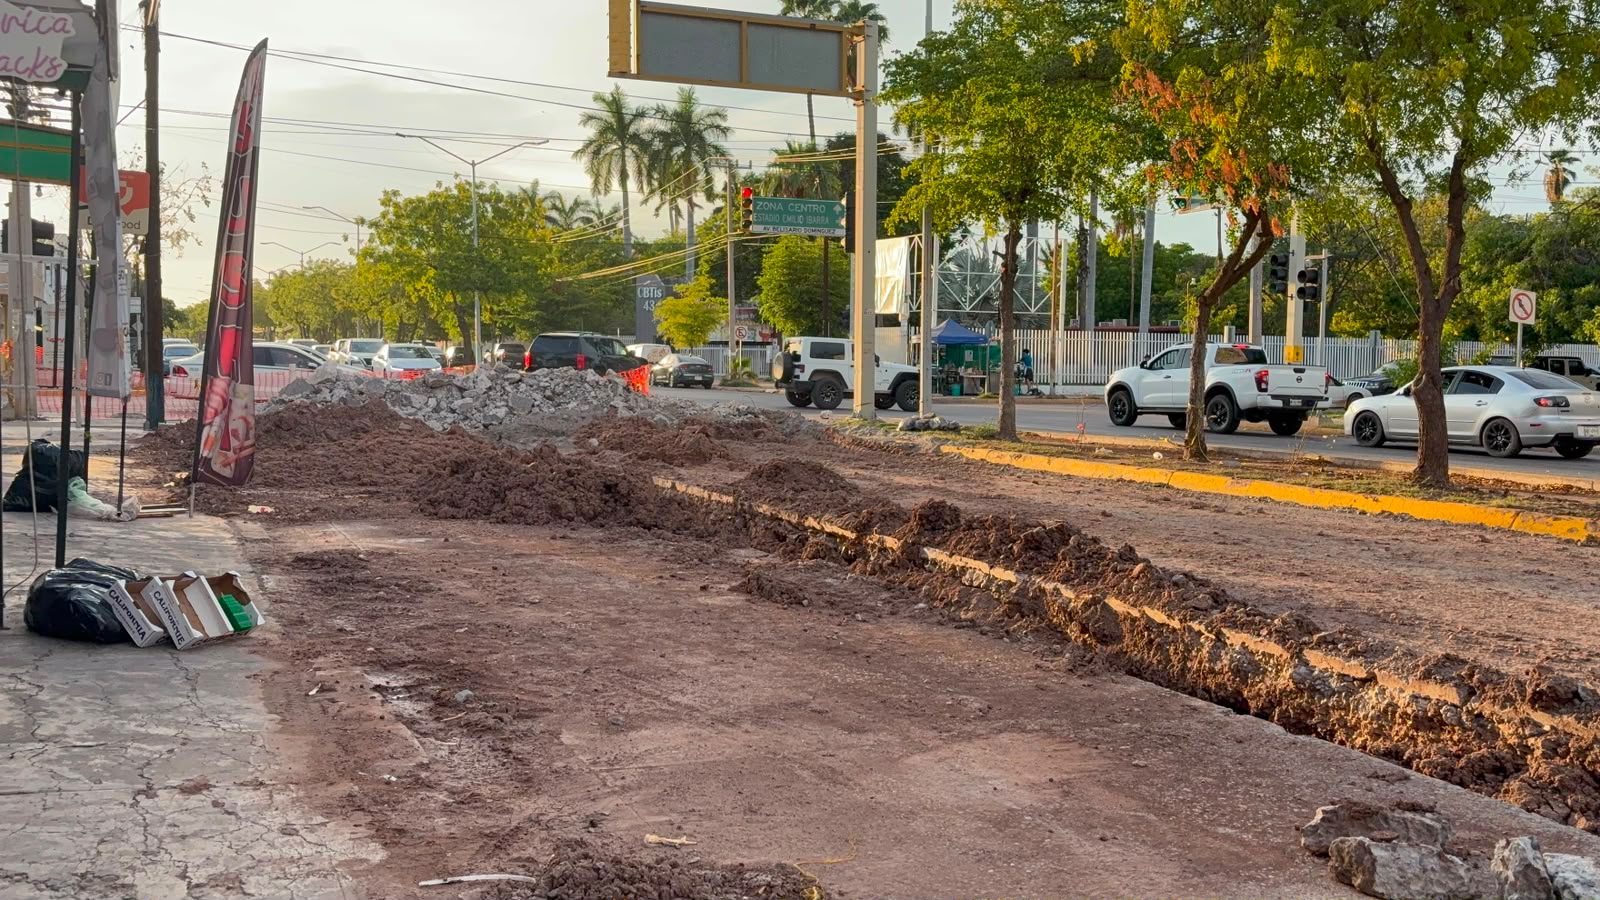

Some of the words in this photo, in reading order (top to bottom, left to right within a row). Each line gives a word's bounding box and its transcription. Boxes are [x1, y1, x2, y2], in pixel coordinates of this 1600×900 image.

[756, 201, 784, 211] ZONA
[788, 203, 826, 213] CENTRO
[121, 220, 141, 230] ood
[753, 213, 780, 222] ESTADIO
[782, 214, 803, 224] EMILIO
[805, 215, 830, 225] IBARRA
[637, 286, 662, 298] CBTis
[108, 589, 146, 641] CALIFORNIA
[153, 590, 186, 646] CALIFORNIE
